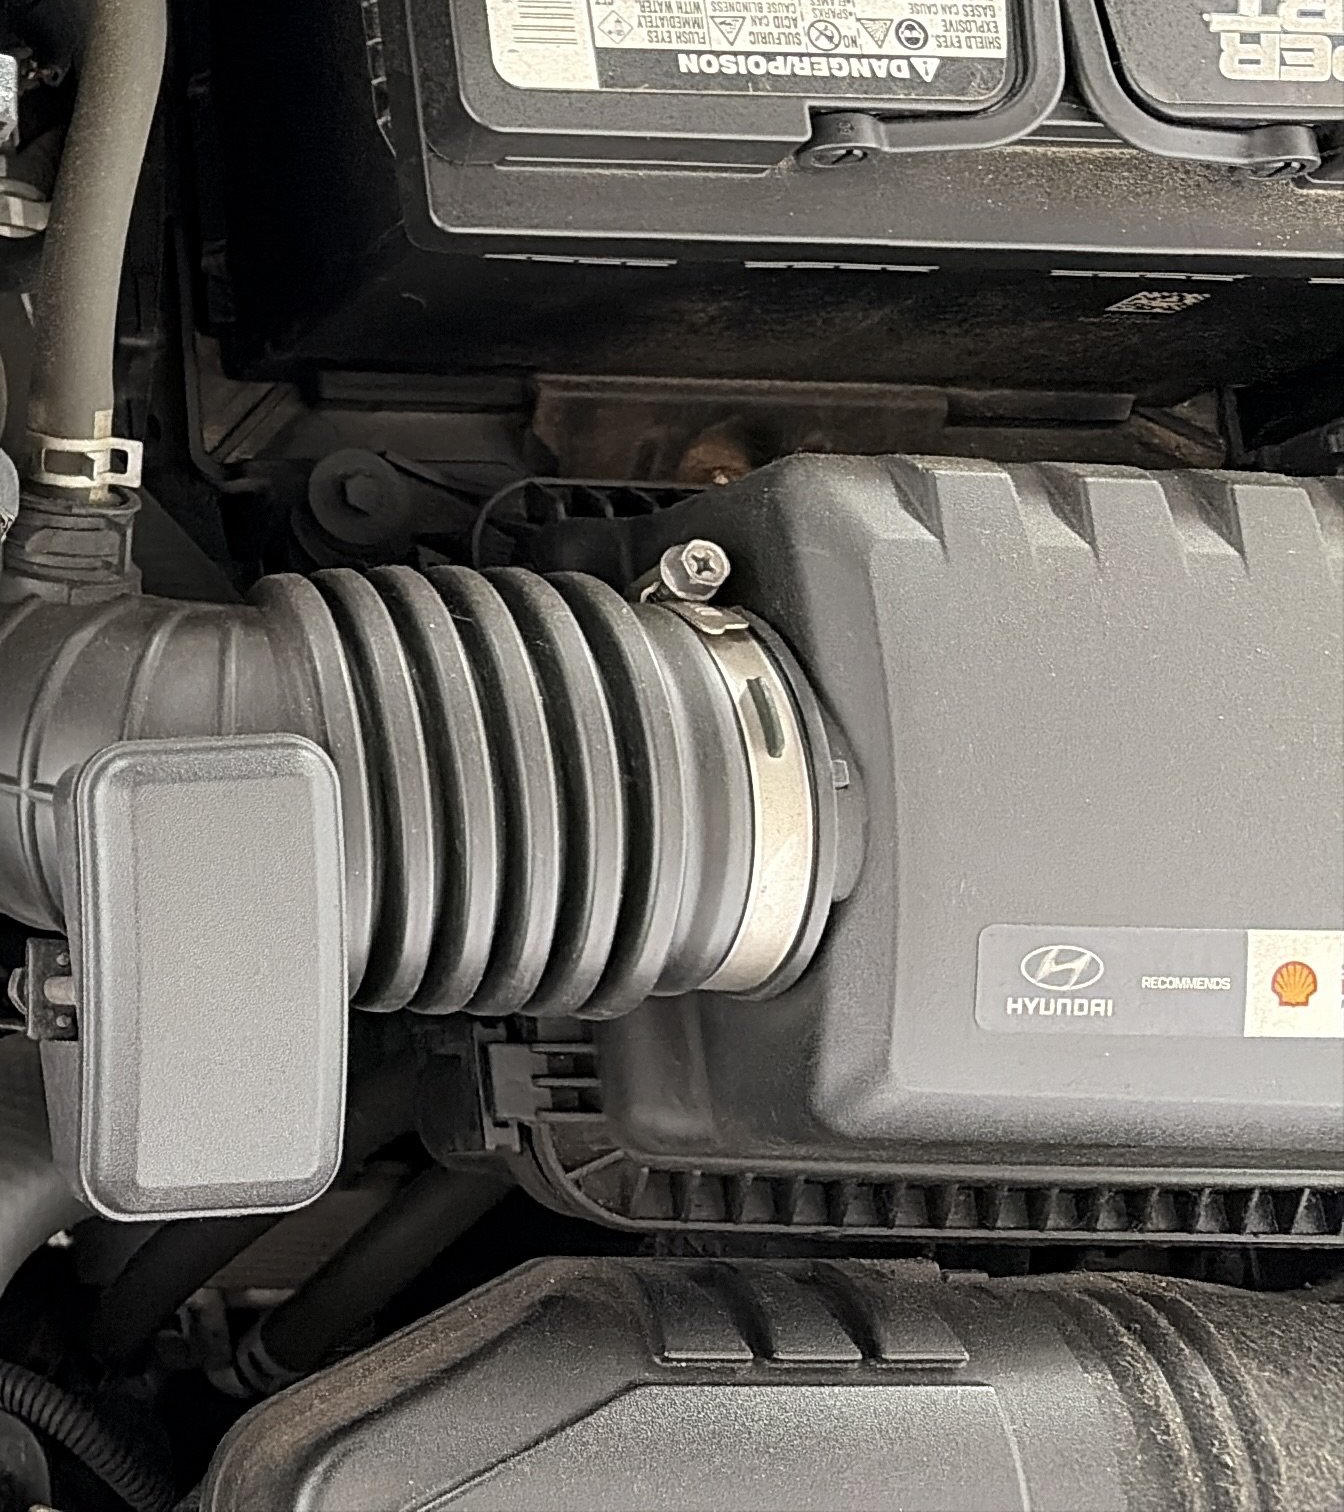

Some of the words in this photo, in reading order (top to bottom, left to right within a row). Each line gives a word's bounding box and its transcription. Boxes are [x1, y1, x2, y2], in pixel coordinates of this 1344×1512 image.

[675, 0, 701, 14] WITH
[710, 1, 763, 14] BLINDNESS
[766, 2, 796, 15] CAUSE
[908, 2, 938, 16] CAUSE
[940, 3, 959, 17] CAN
[961, 4, 995, 18] GASES
[636, 15, 704, 29] IMMEDIATELY
[750, 15, 769, 28] CAN
[772, 15, 798, 28] ACID
[941, 19, 998, 34] EXPLOSIVE
[646, 30, 672, 44] EYES
[675, 31, 706, 44] FLUSH
[748, 31, 801, 45] SULFURIC
[842, 35, 857, 46] NO
[964, 35, 1001, 50] SHIELD
[677, 54, 910, 78] DANGER/POISON
[1006, 997, 1113, 1016] HYUNDAI
[1141, 976, 1230, 991] RECOMMENDS
